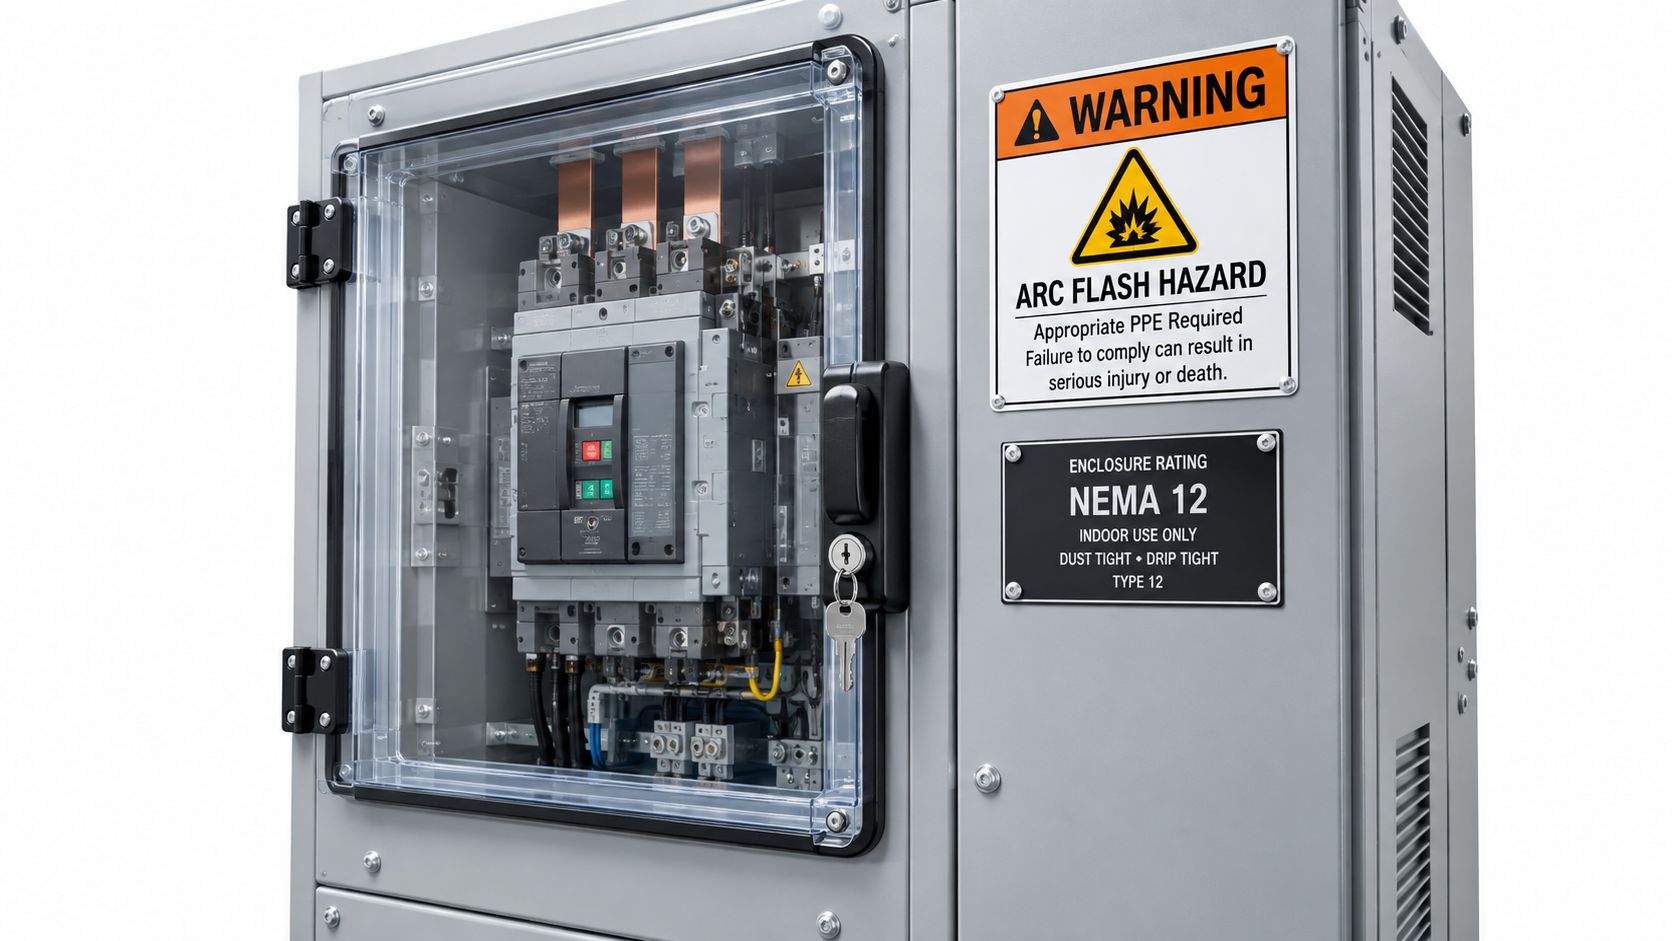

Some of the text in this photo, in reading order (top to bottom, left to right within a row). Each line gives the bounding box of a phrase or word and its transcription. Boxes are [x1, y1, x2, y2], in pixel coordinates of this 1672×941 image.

[1070, 66, 1266, 135] WARNING
[1016, 260, 1267, 310] ARC FLASH HAZARD
[1034, 306, 1243, 344] Appropriate PPE Required
[1026, 333, 1253, 367] Failure to comply can result in
[1048, 362, 1228, 391] serious injury or death.
[1069, 453, 1208, 474] ENCLOSURE RATING
[1070, 483, 1208, 517] NEMA 12
[1079, 527, 1198, 543] INDOOR USE ONLY
[1059, 551, 1220, 566] DUST TIGHT DRIP TIGHT
[1112, 574, 1164, 589] TYPE 12
